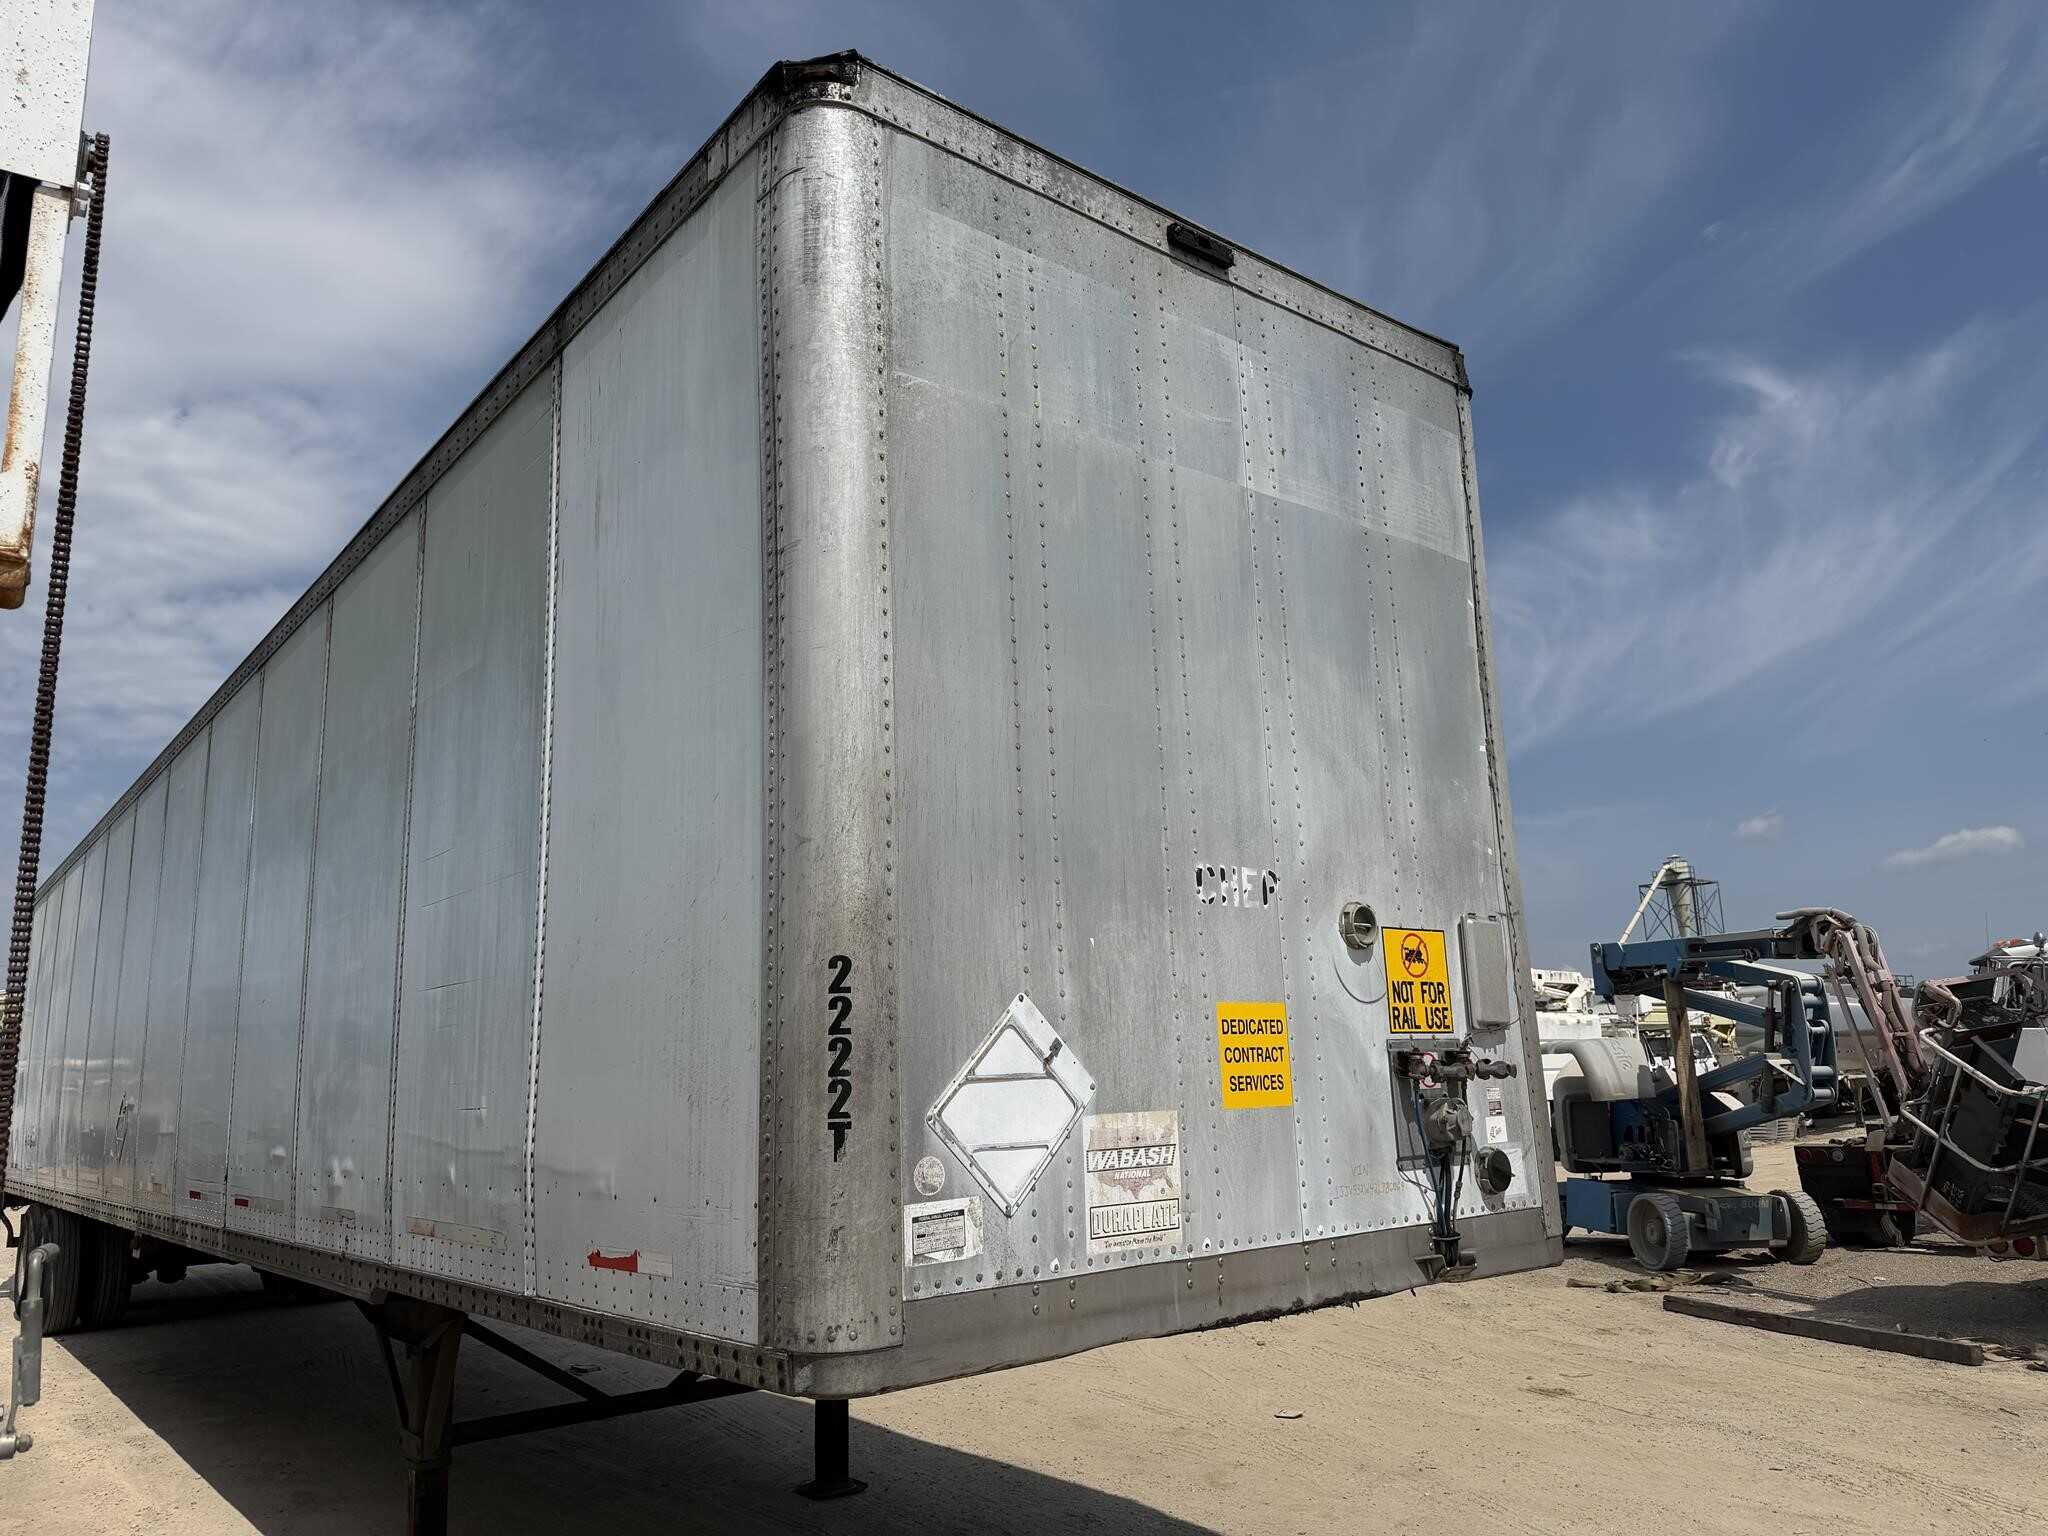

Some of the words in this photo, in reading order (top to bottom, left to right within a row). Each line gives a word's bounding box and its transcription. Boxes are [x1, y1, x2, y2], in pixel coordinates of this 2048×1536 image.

[1392, 980, 1414, 1004] NOT
[1420, 981, 1446, 1004] FOR
[1221, 1018, 1284, 1035] DEDICATED
[1392, 1006, 1421, 1030] RAIL
[1425, 1006, 1450, 1030] USE
[1224, 1046, 1285, 1063] CONTRACT
[1229, 1074, 1285, 1092] SERVICES
[1089, 1145, 1174, 1171] WABASH
[1114, 1169, 1151, 1180] NATIONAL
[1092, 1203, 1179, 1236] DURAPLATE
